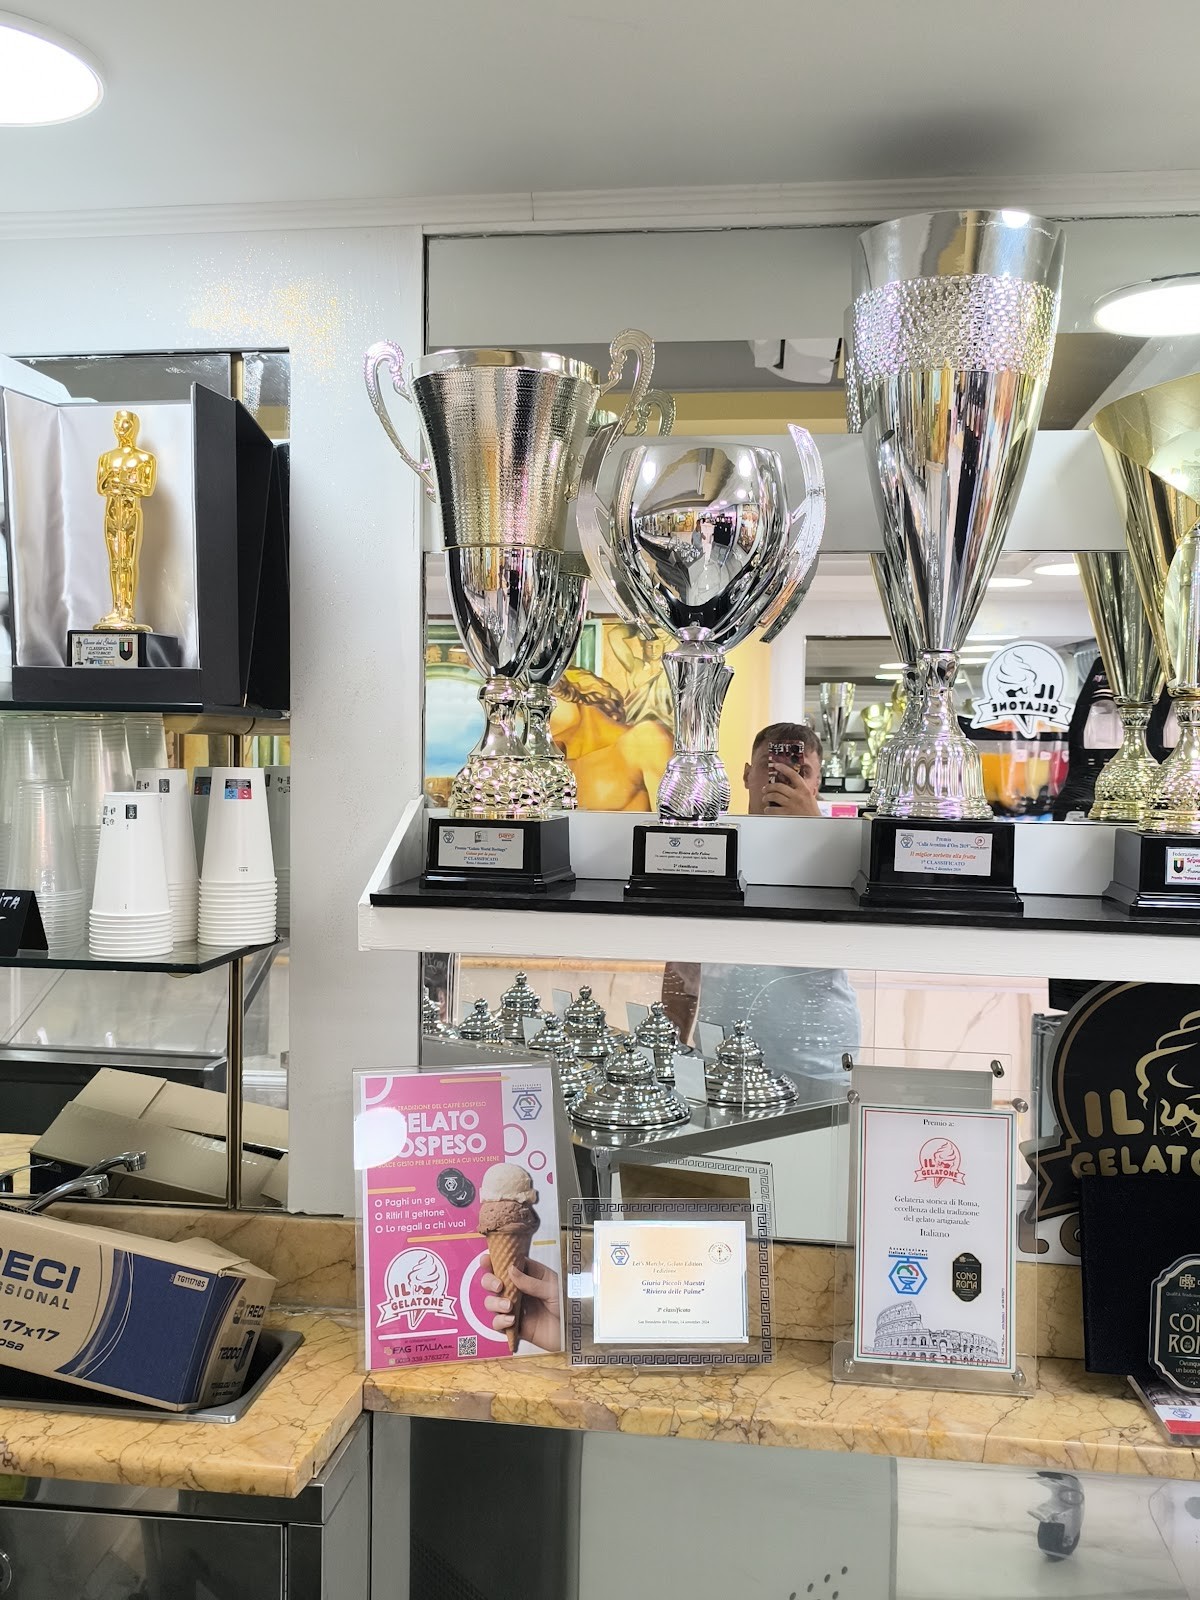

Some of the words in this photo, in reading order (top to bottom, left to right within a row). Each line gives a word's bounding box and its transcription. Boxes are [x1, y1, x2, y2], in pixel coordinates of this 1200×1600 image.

[1084, 1088, 1145, 1138] IL
[406, 1110, 480, 1133] ELATO
[923, 1118, 947, 1126] Premio
[397, 1133, 487, 1158] OSPESO
[924, 1158, 935, 1168] IL
[922, 1169, 958, 1178] GELATONE
[385, 1197, 410, 1207] Paghi
[424, 1197, 436, 1206] ge
[894, 1195, 924, 1204] Gelateria
[958, 1199, 980, 1208] Roma,
[385, 1211, 403, 1220] Ritiri
[404, 1210, 410, 1219] il
[412, 1209, 445, 1220] gettone
[894, 1206, 928, 1214] eccellenza
[929, 1206, 946, 1214] della
[946, 1208, 980, 1217] tradizione
[398, 1222, 422, 1232] regali
[432, 1220, 446, 1230] chi
[448, 1219, 466, 1228] vuoi
[916, 1216, 936, 1224] gelato
[936, 1218, 970, 1226] artigianale
[920, 1228, 950, 1238] Italiano
[0, 1248, 80, 1294] ECI
[956, 1271, 978, 1280] CONO
[394, 1282, 410, 1298] IL
[956, 1280, 978, 1290] ROMA
[391, 1296, 444, 1311] GELATONE
[2, 1318, 60, 1342] 17x17
